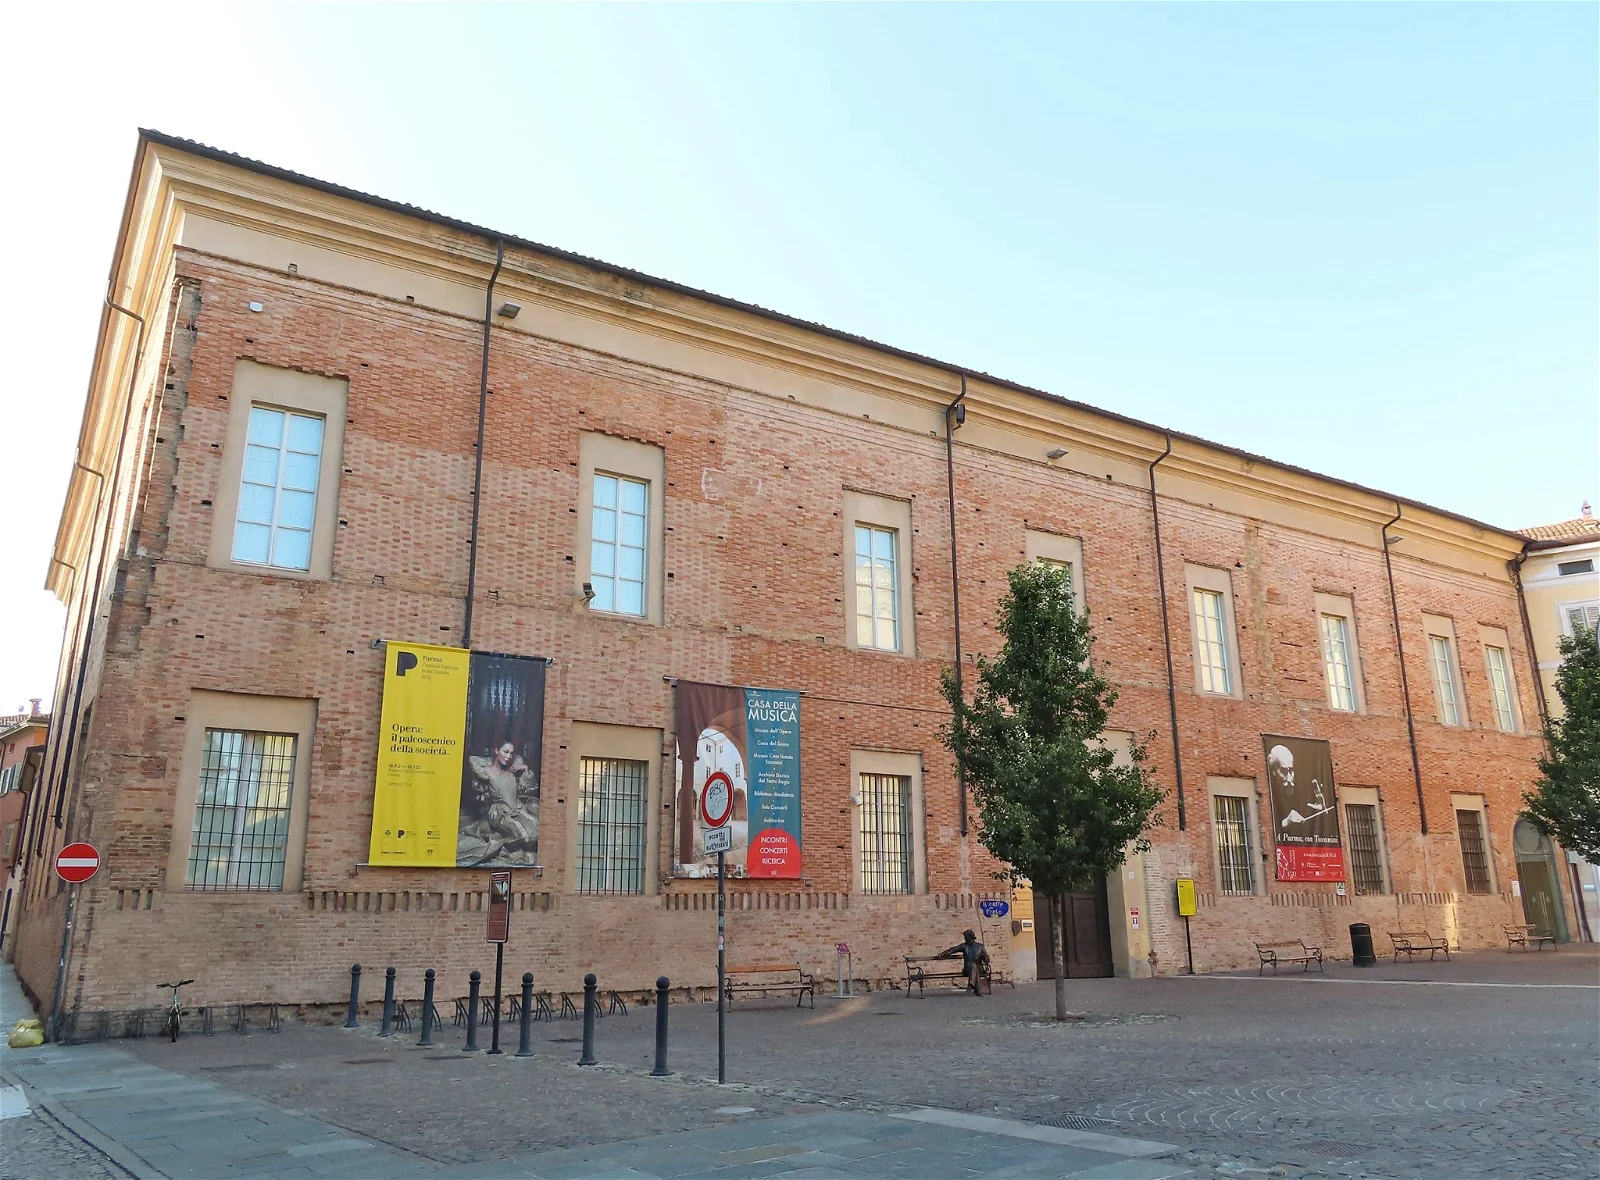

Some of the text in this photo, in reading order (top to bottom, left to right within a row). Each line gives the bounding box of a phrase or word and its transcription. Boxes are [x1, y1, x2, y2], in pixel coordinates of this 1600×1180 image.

[396, 651, 418, 676] P
[748, 700, 797, 710] CASA DELLA
[748, 709, 797, 722] MUSICA
[392, 723, 423, 733] Opera:
[391, 733, 456, 746] il palcoscenico
[390, 744, 450, 756] della società.
[1283, 833, 1304, 842] Parma,
[1314, 835, 1338, 843] Toscanini
[1287, 871, 1296, 879] 150
